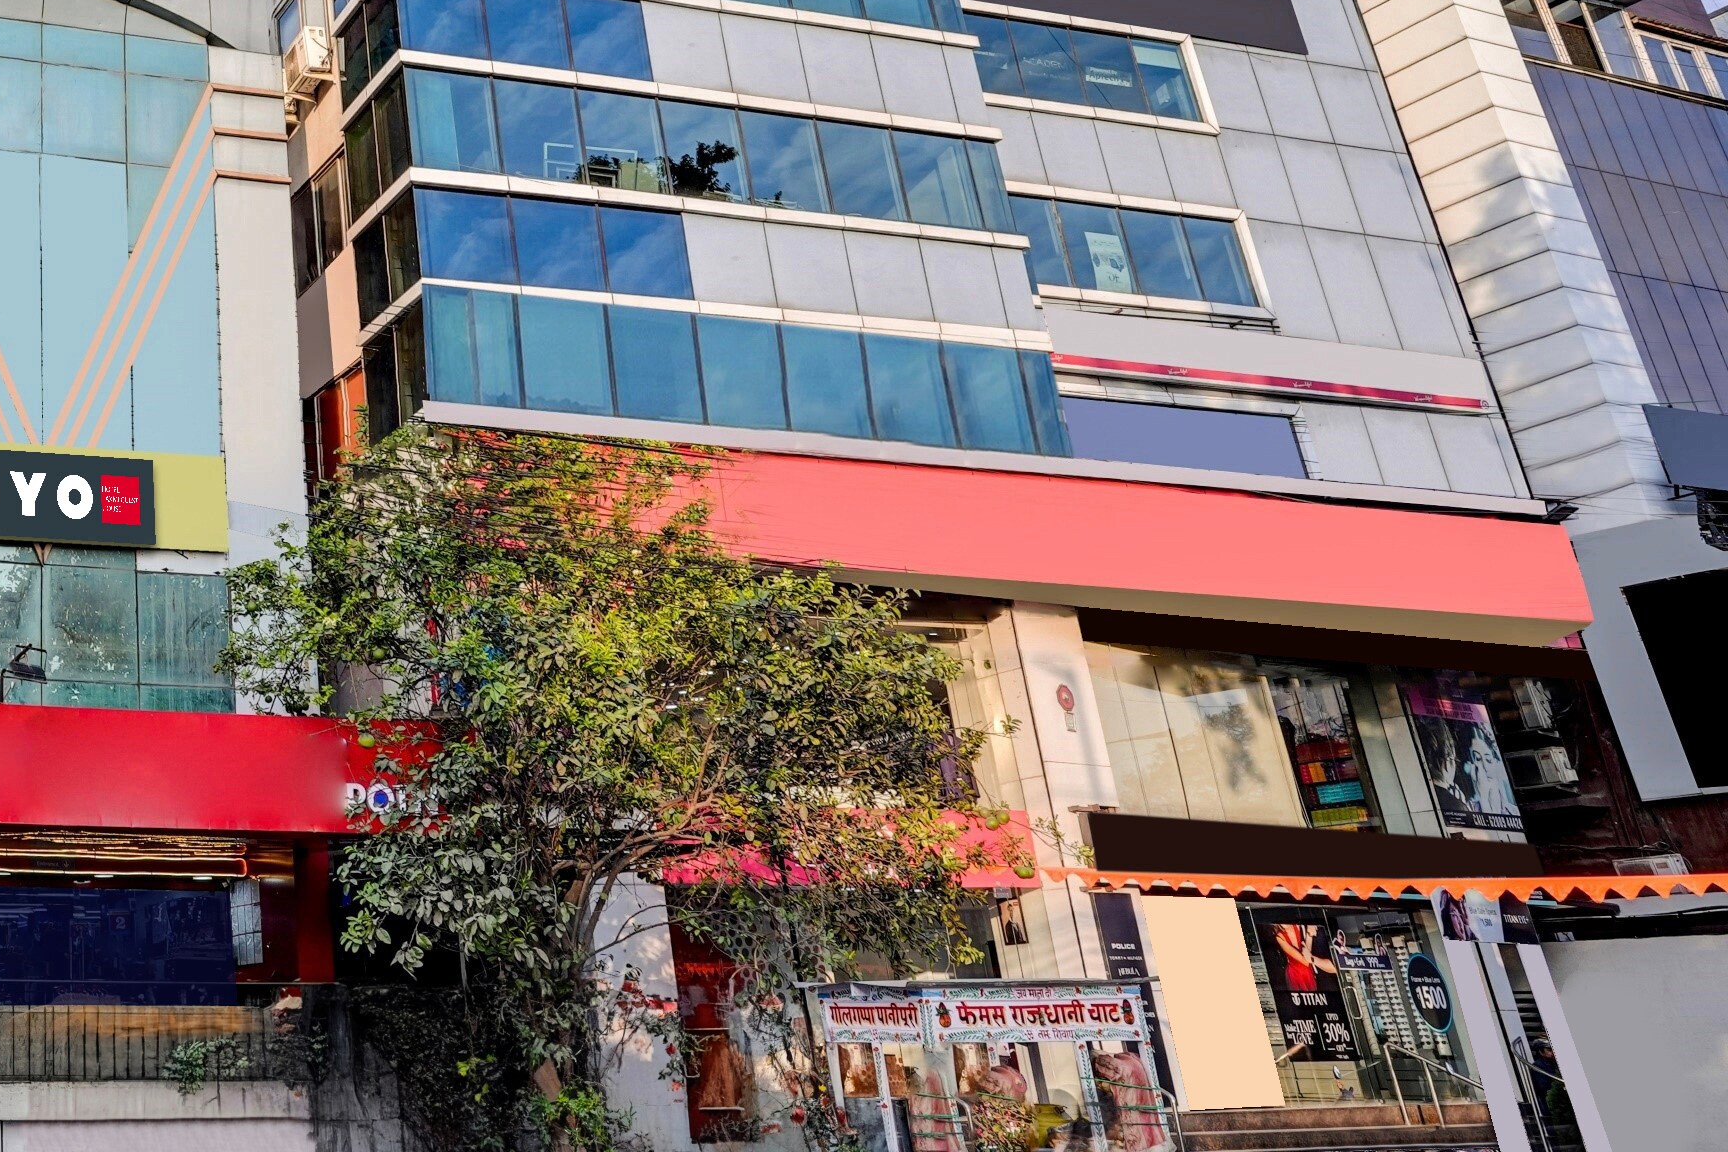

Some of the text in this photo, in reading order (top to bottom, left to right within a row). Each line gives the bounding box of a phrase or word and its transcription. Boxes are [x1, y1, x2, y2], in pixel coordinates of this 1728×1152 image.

[115, 915, 126, 929] 2
[1110, 942, 1136, 950] POLICE
[1300, 992, 1328, 1006] TITAN
[955, 999, 1120, 1027] फेमस राजधानी चाट
[1292, 1019, 1317, 1033] TIME
[1322, 1022, 1350, 1044] 30%
